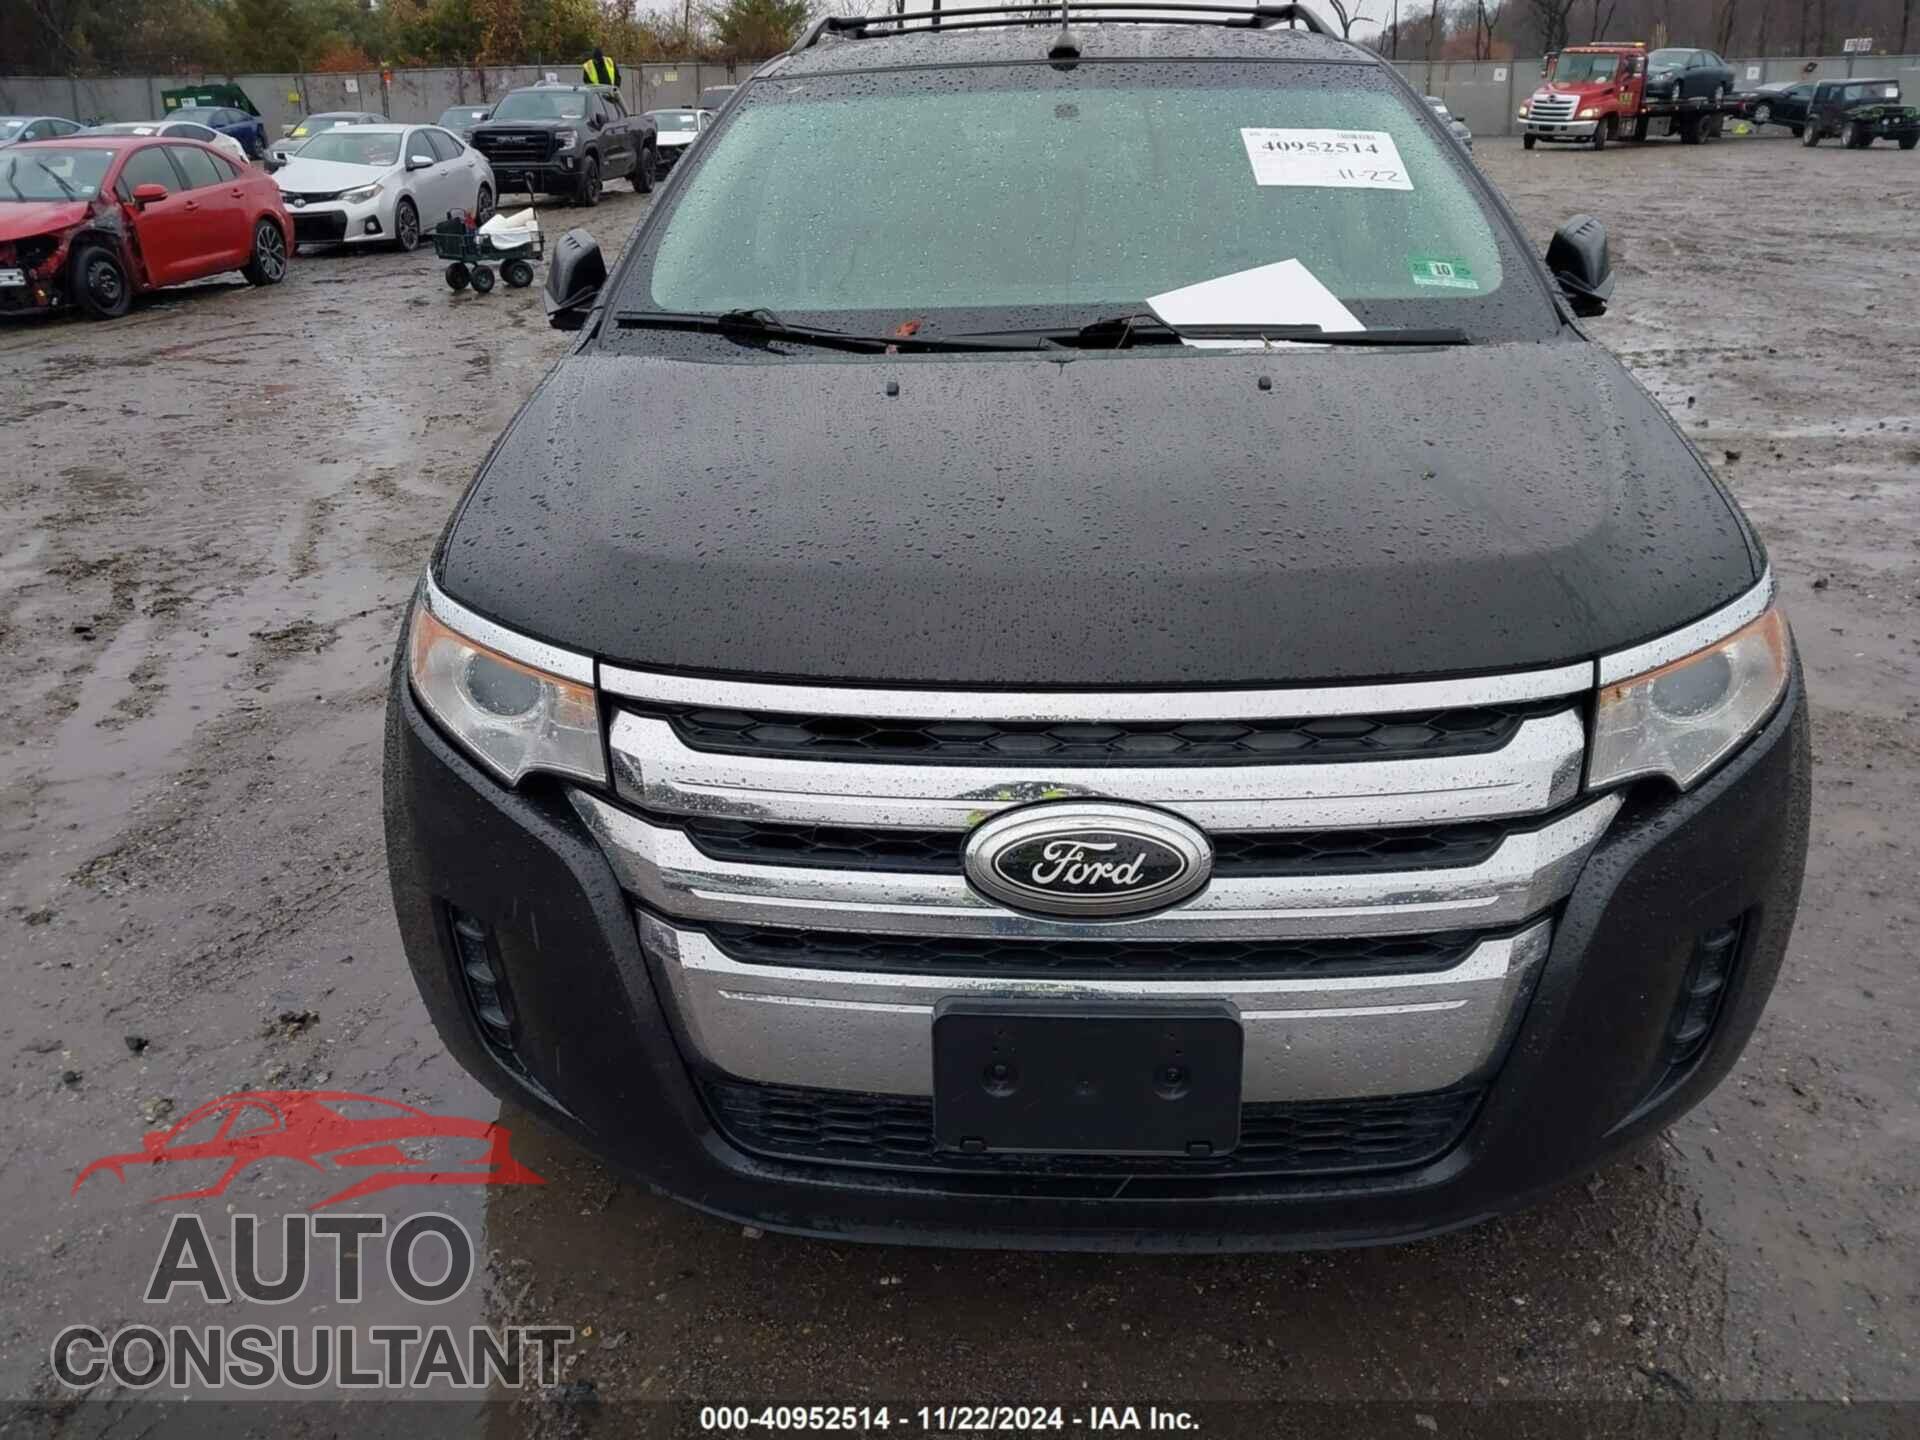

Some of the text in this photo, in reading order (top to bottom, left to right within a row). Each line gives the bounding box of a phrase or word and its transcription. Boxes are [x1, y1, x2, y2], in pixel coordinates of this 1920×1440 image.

[1261, 140, 1380, 155] 40952514
[1434, 263, 1451, 276] 10
[1032, 840, 1147, 885] Ford
